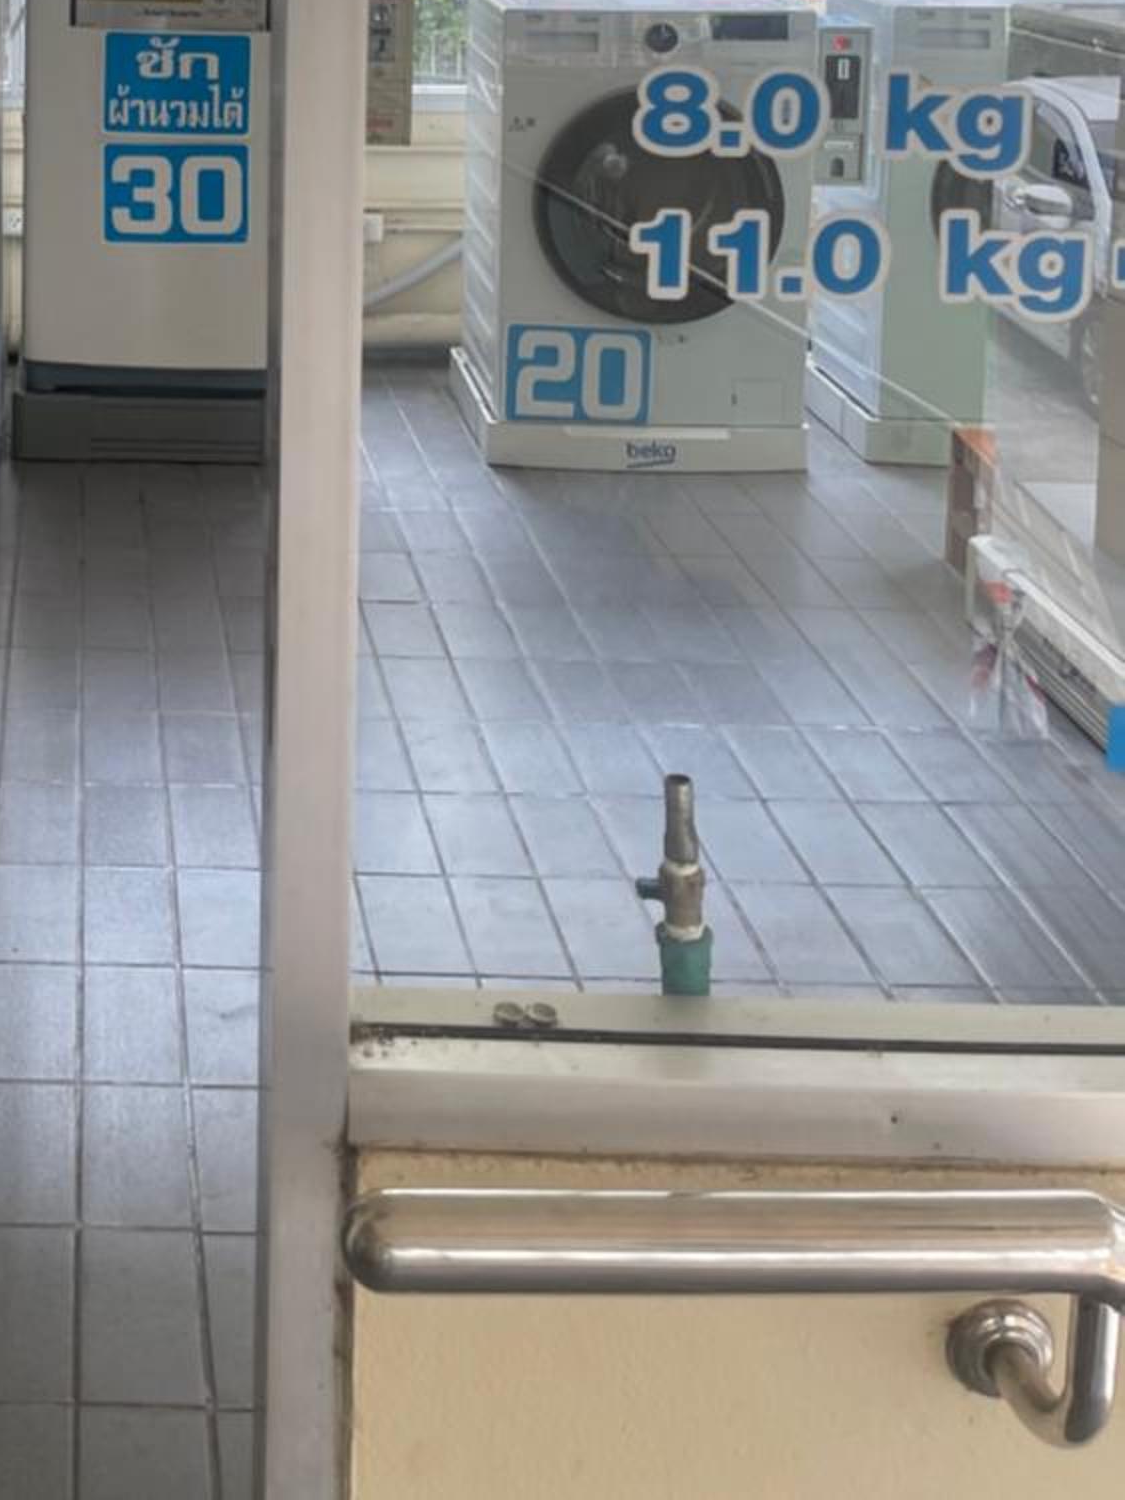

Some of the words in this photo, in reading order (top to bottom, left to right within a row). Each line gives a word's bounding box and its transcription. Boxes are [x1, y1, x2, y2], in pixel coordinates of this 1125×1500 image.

[108, 85, 244, 130] ผ้านวมได้
[638, 69, 824, 155] 8.0
[883, 71, 1027, 173] kg
[110, 154, 244, 236] 30
[634, 209, 885, 298] 11.0
[945, 215, 1088, 316] kg
[513, 328, 644, 419] 20
[625, 440, 677, 464] beko
